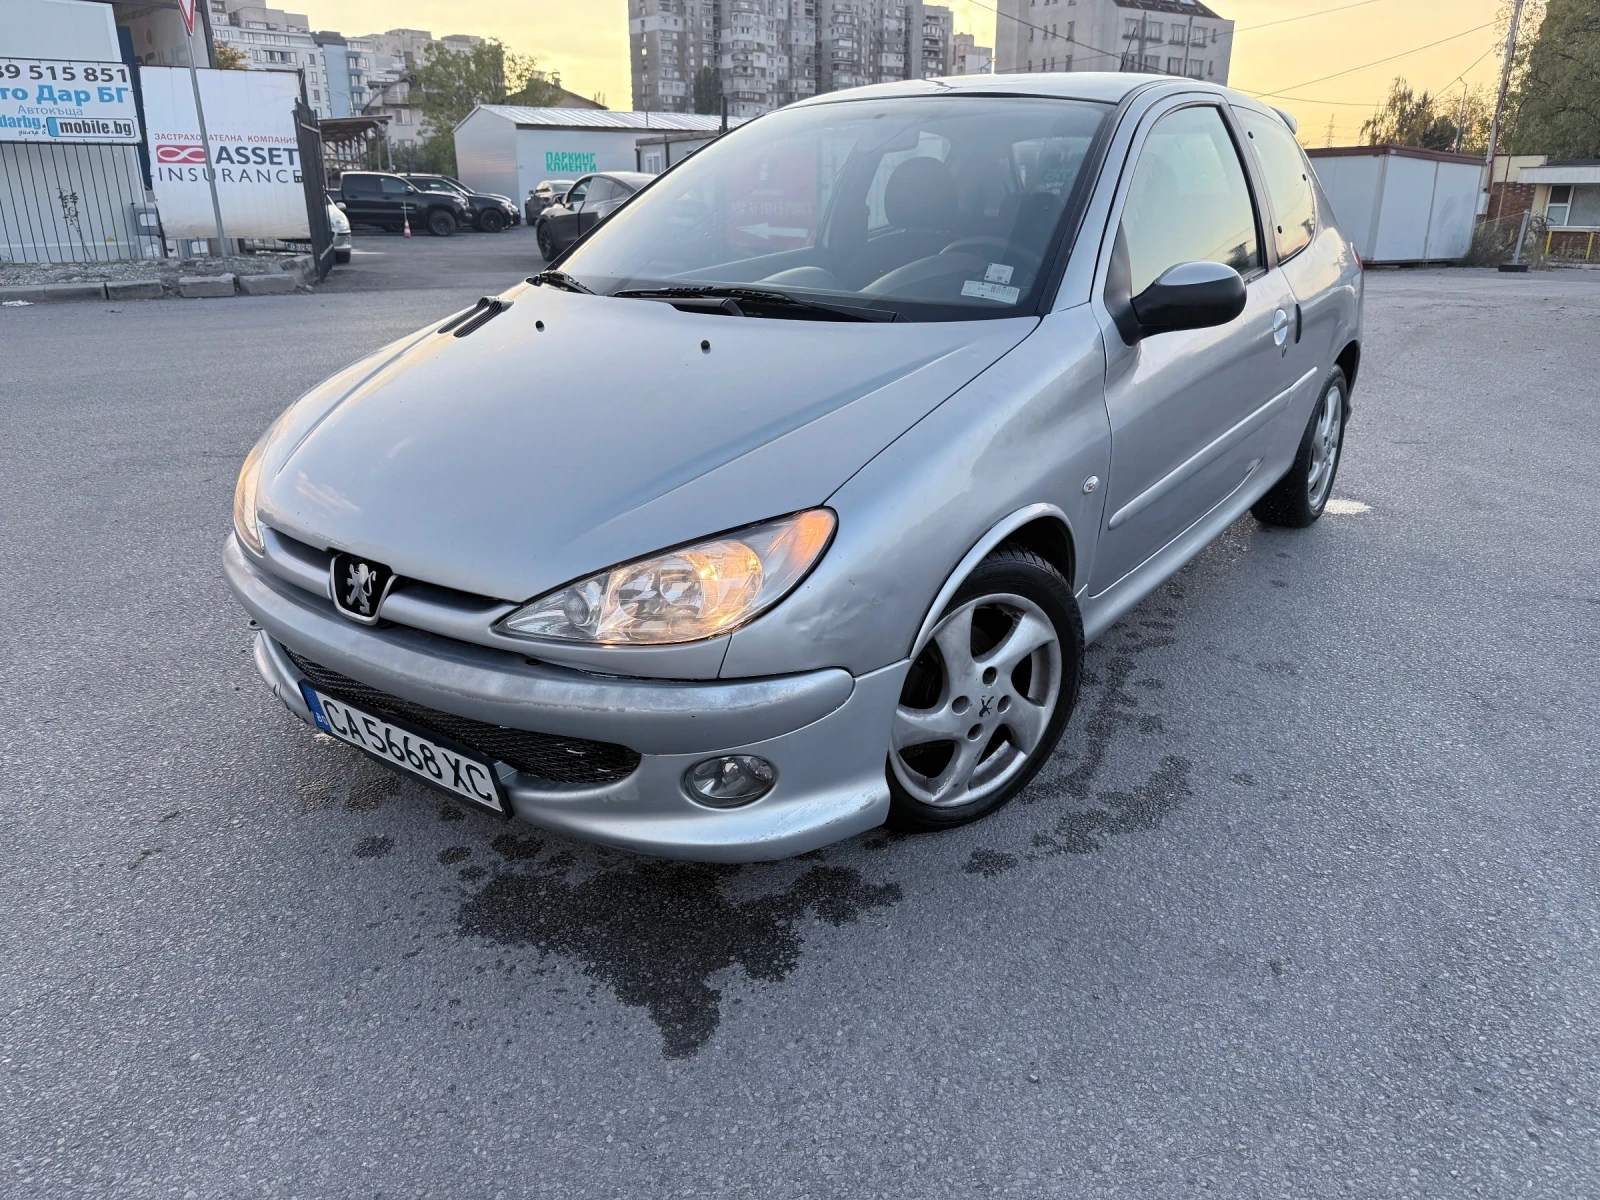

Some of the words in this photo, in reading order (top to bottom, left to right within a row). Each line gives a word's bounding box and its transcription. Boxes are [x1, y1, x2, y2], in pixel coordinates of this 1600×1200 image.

[29, 65, 76, 81] 515
[83, 67, 127, 82] 851
[36, 84, 91, 106] Дар
[97, 86, 129, 103] БГ
[18, 104, 83, 117] Автокъща
[59, 120, 132, 136] mobile.bg
[155, 132, 243, 143] ЗАСТРАХОАТЕЛНА
[247, 135, 298, 144] КОМПАНИЯ
[215, 145, 299, 166] ASSET
[545, 151, 596, 163] ПАРКИНГ
[546, 162, 597, 172] КЛИЕНТИ
[315, 711, 330, 726] BG
